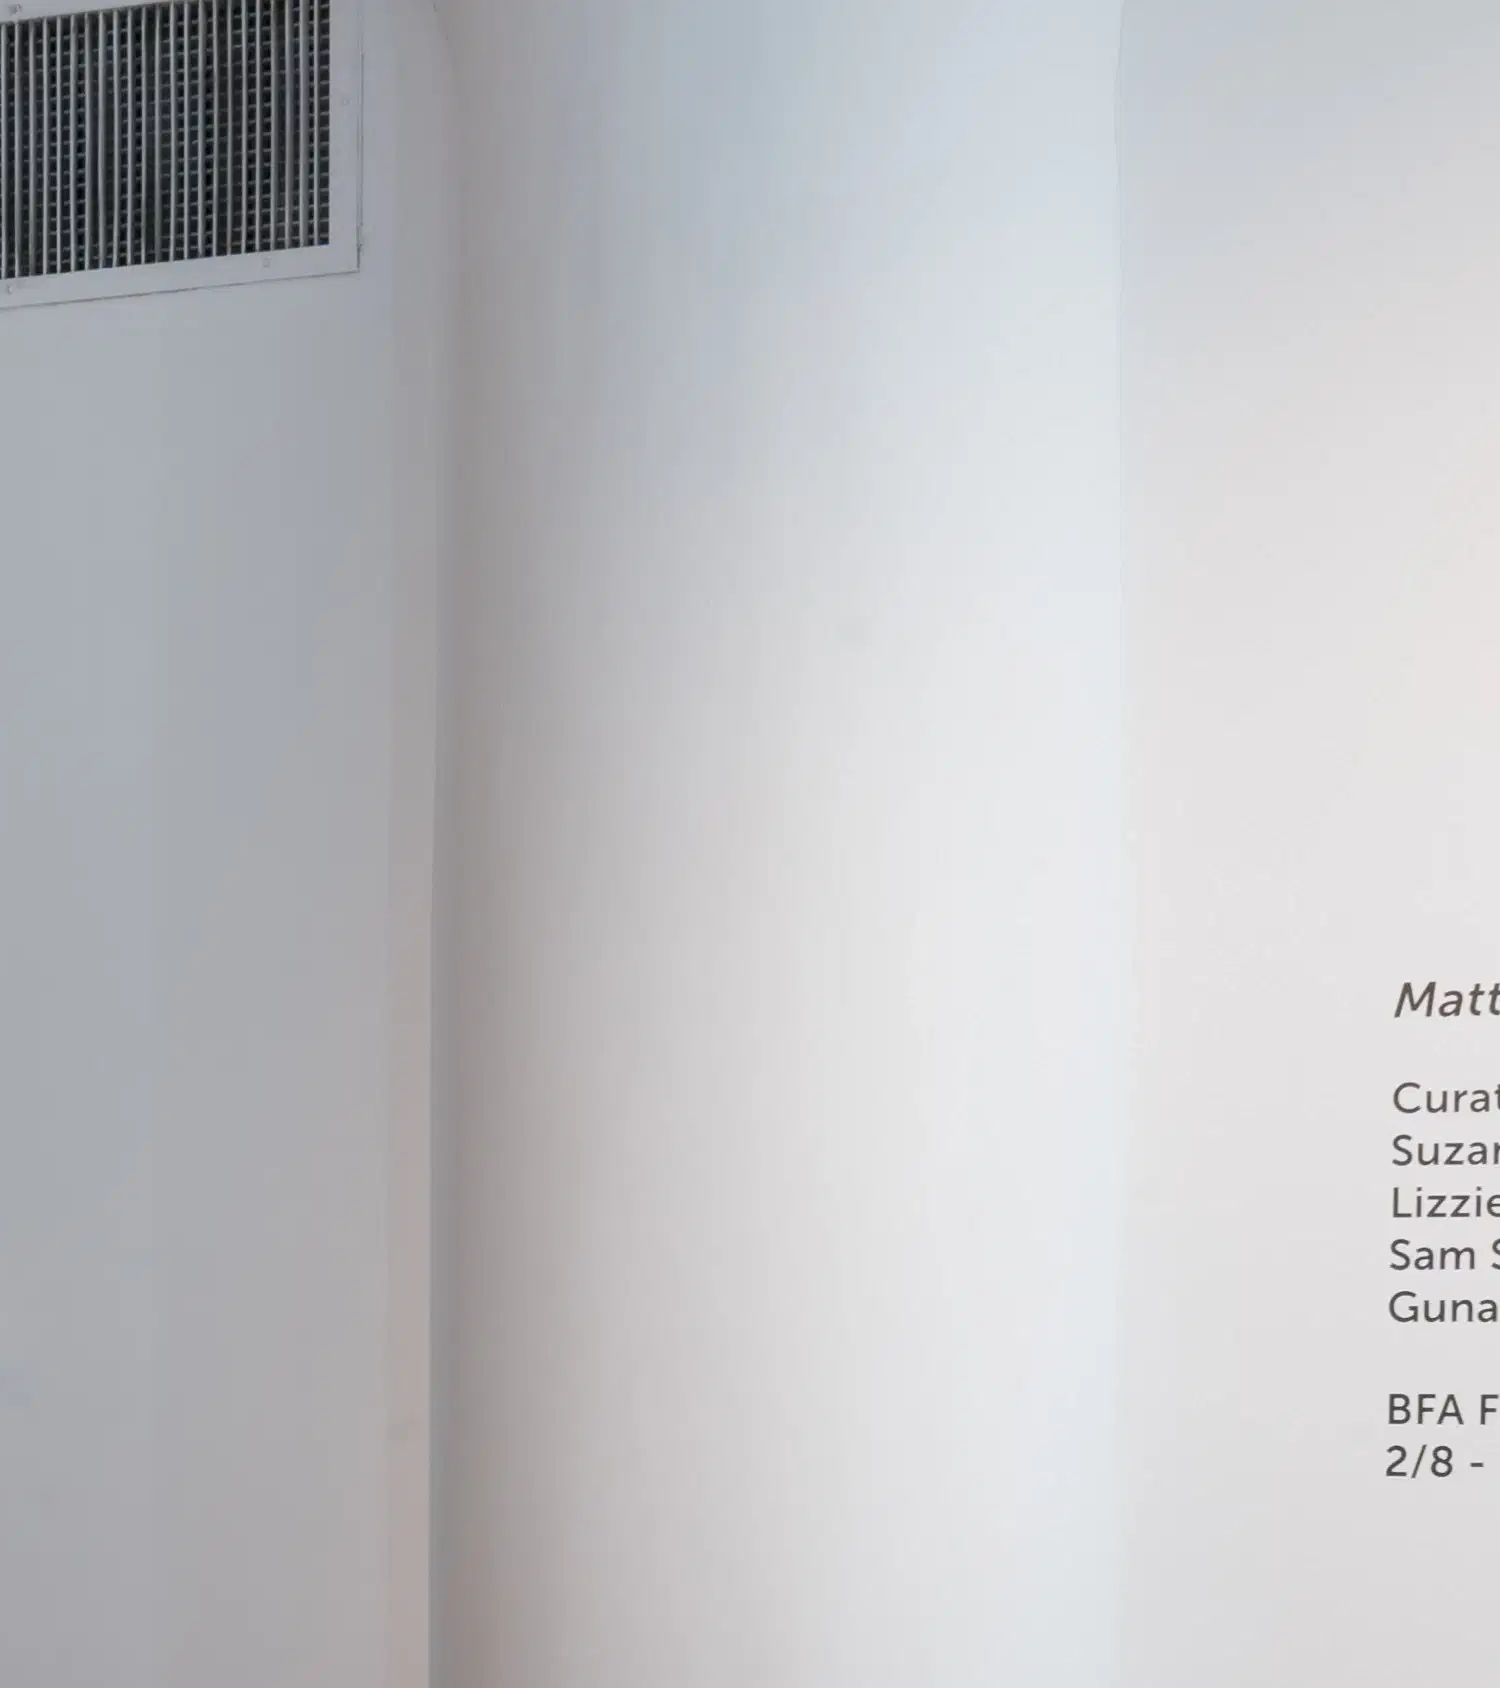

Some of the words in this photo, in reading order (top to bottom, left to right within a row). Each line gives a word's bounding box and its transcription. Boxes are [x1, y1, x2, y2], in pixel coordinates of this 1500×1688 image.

[1389, 1238, 1476, 1272] Sam
[1387, 1393, 1465, 1426] BFA
[1385, 1443, 1454, 1480] 2/8
